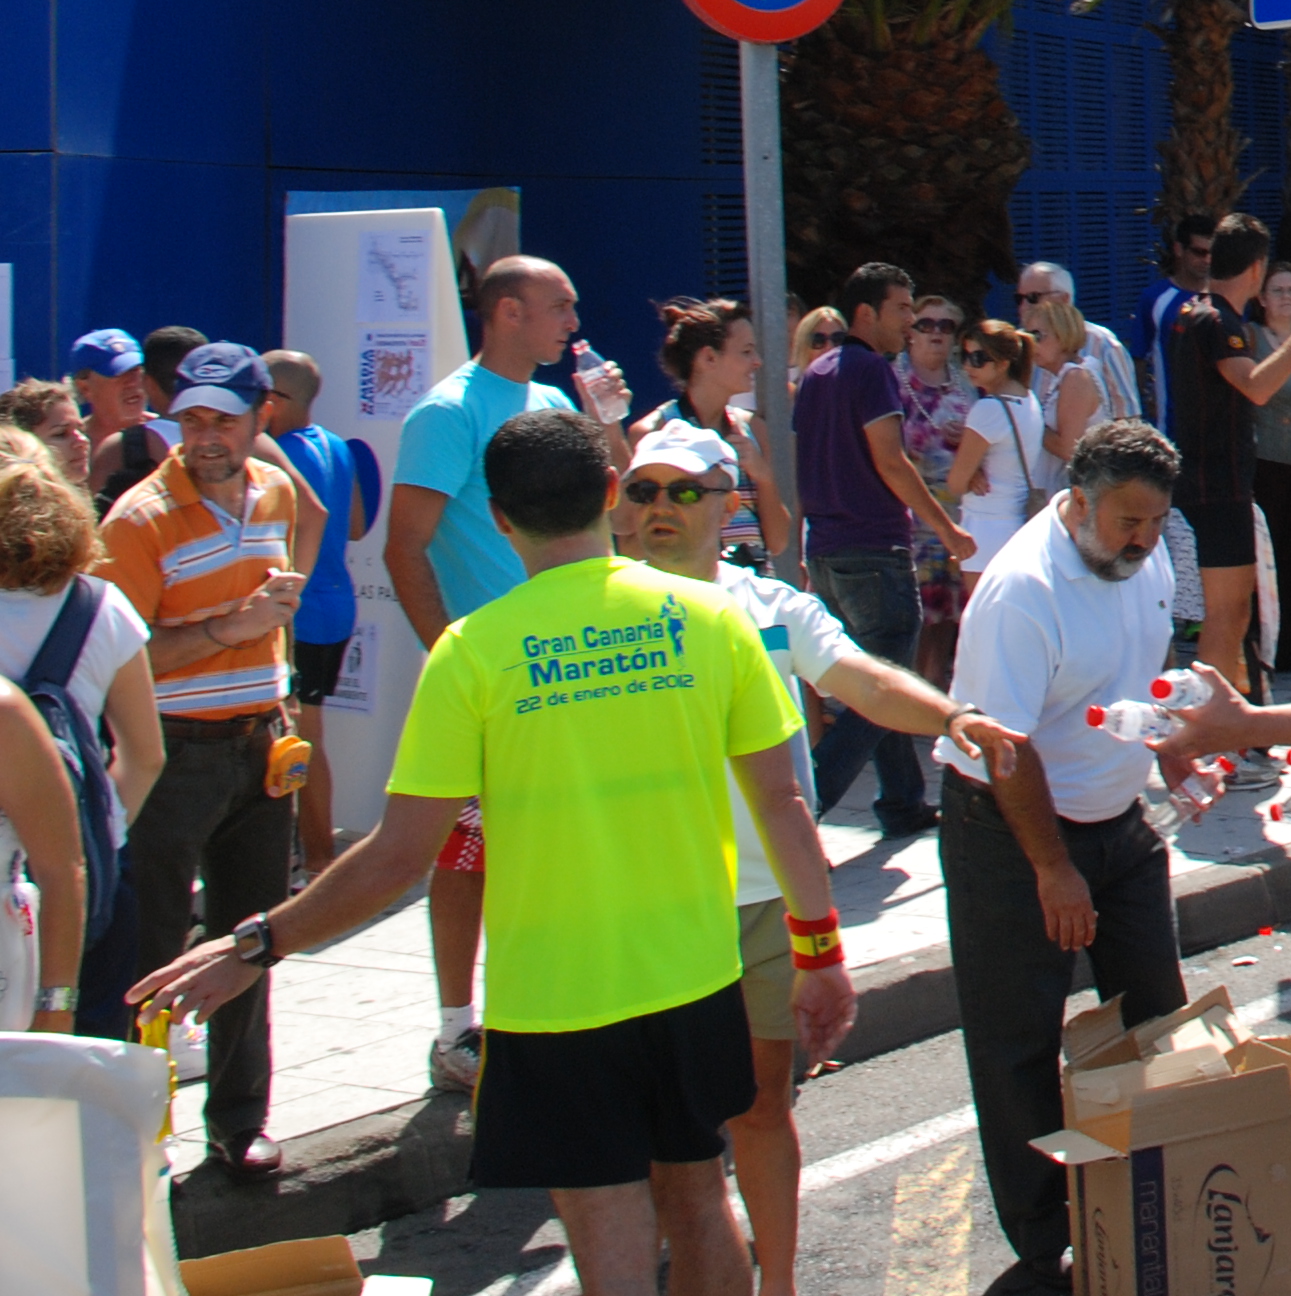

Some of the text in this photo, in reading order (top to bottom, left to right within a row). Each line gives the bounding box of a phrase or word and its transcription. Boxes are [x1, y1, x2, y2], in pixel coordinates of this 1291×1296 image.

[523, 617, 665, 658] Gran Canaria
[527, 647, 669, 688] Maratón
[515, 673, 696, 715] 22 de enero de 2012
